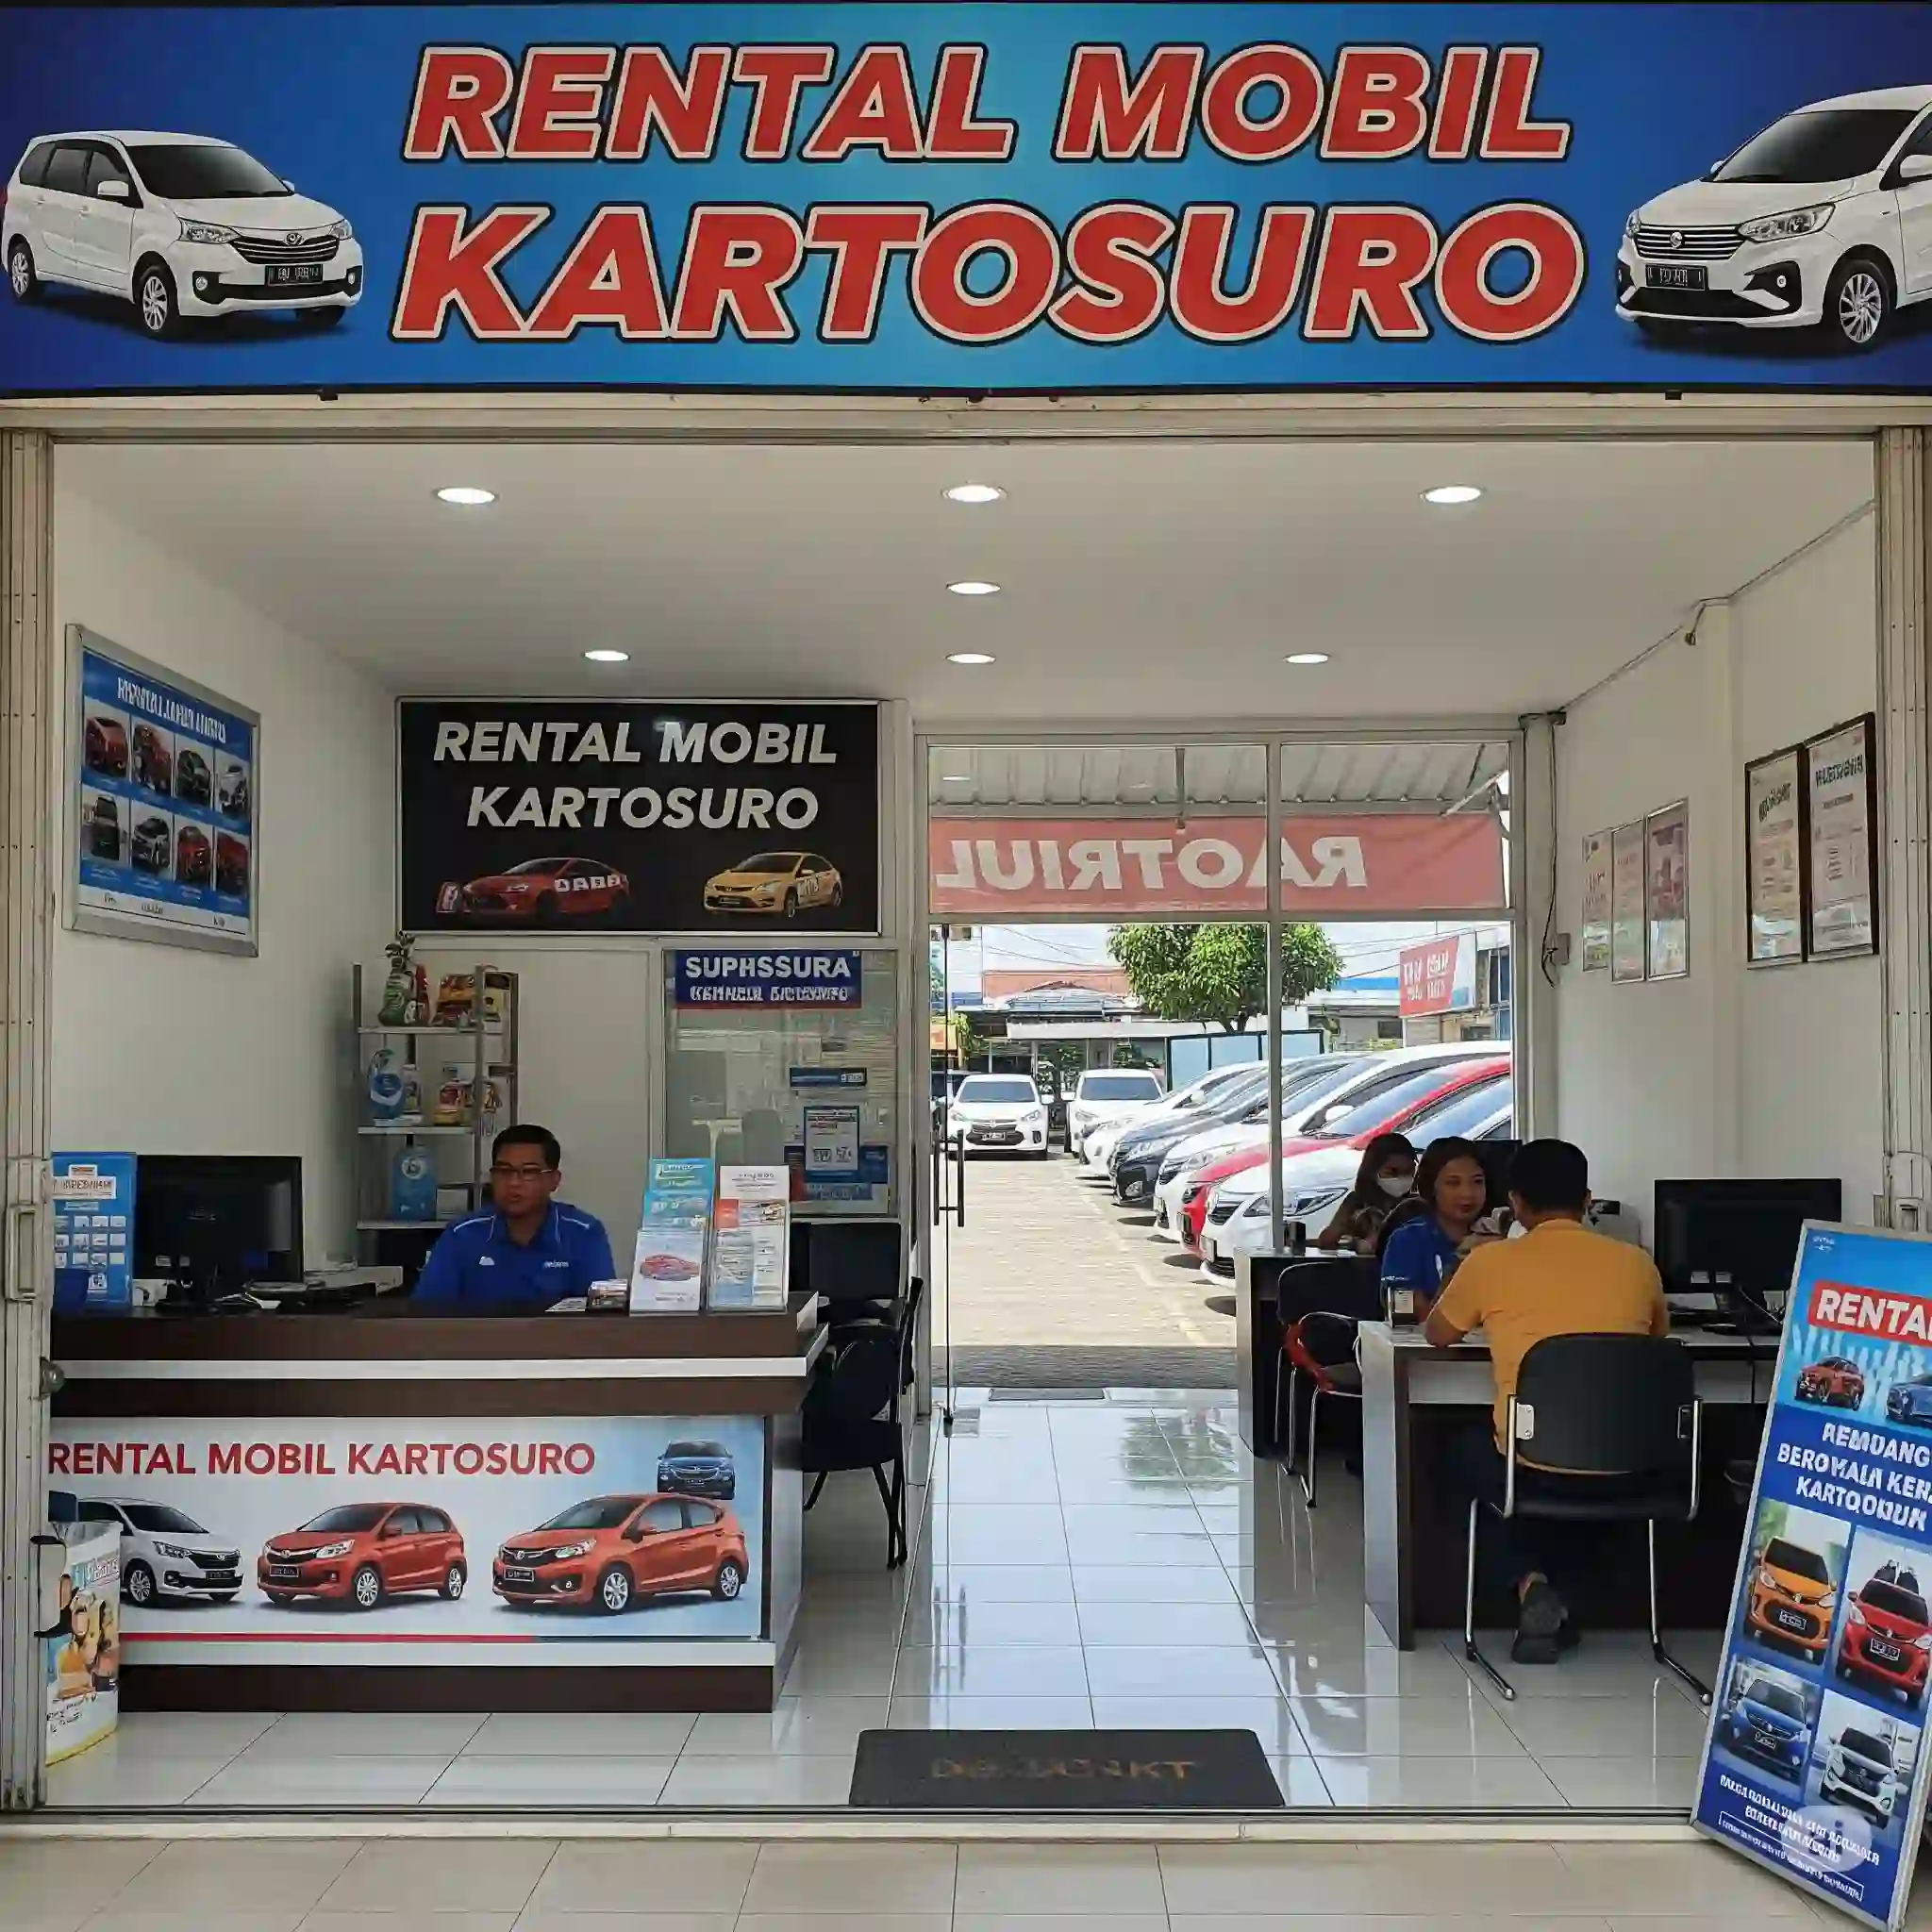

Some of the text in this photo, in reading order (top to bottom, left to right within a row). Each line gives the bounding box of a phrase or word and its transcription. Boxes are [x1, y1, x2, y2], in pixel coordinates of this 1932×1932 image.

[404, 44, 1572, 161] RENTAL MOBIL
[391, 201, 1585, 343] KARTOSURO
[433, 722, 838, 764] RENTAL MOBIL
[467, 787, 819, 829] KARTOSURO
[1816, 1289, 1932, 1342] RENTA
[48, 1442, 595, 1474] RENTAL MOBIL KARTOSURO
